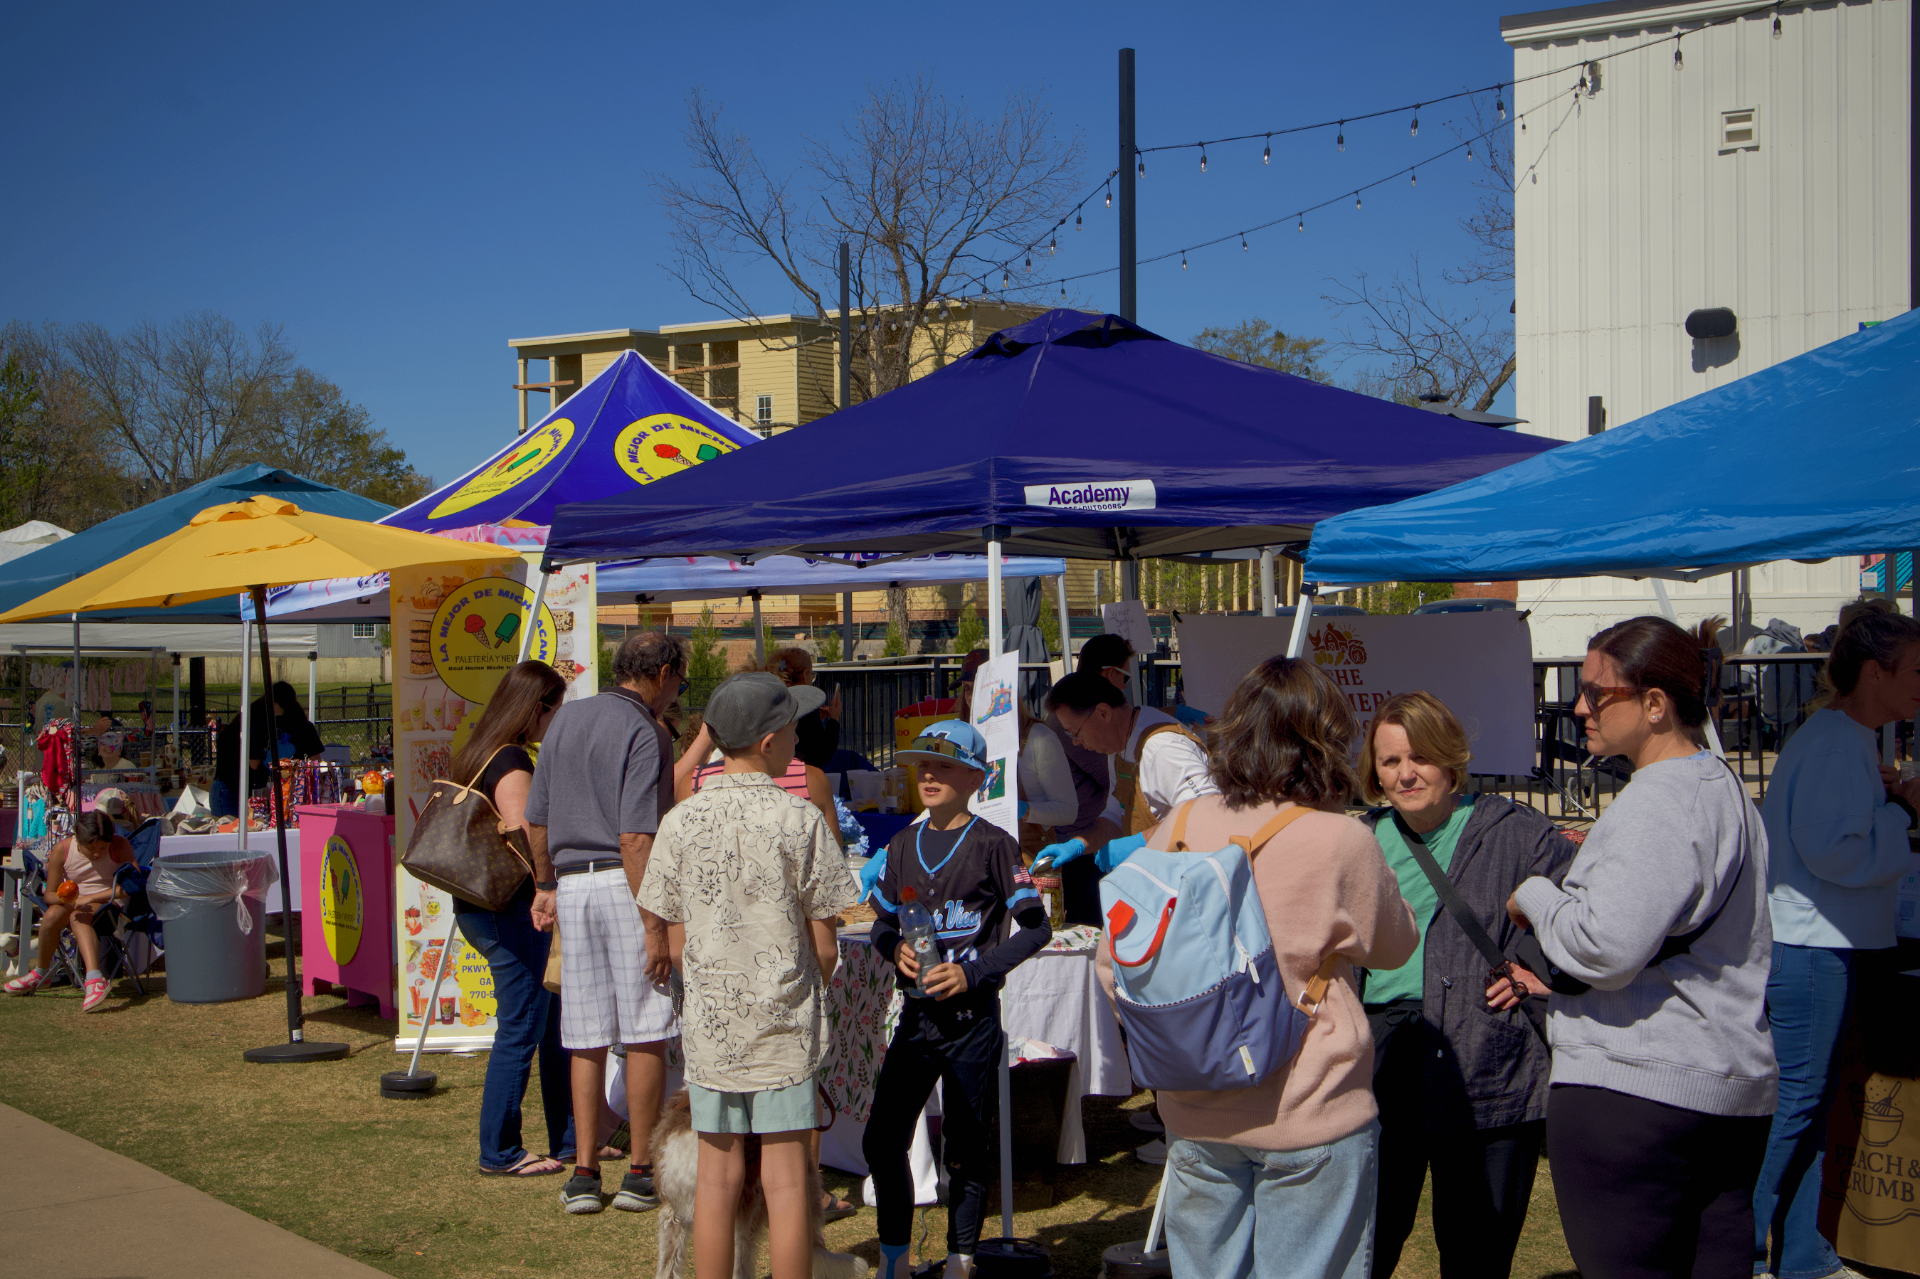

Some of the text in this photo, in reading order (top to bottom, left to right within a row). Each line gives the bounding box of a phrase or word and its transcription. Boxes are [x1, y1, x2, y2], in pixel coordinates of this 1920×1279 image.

[627, 430, 651, 464] MEJOR
[650, 422, 675, 433] DE
[1048, 484, 1130, 507] Academy
[439, 588, 548, 663] LA MEJOR DE MICHACAN
[944, 899, 981, 930] View
[462, 965, 488, 973] PKWY
[465, 952, 477, 960] #4
[479, 977, 492, 986] GA
[1834, 1144, 1920, 1179] PEACH &
[1839, 1169, 1915, 1203] CRUMB
